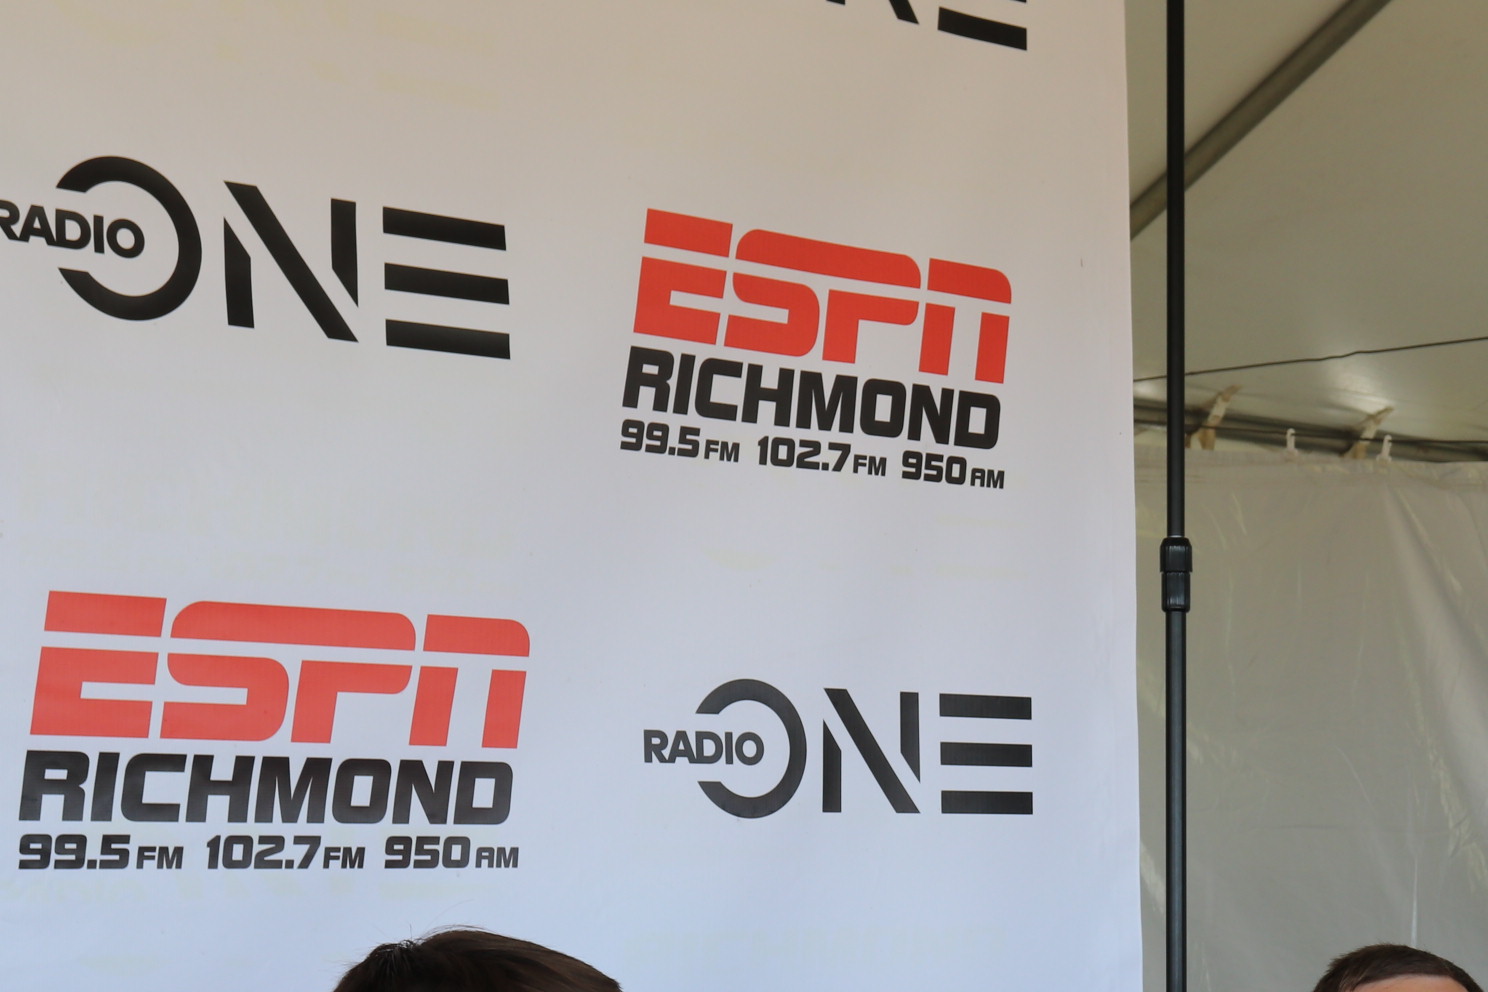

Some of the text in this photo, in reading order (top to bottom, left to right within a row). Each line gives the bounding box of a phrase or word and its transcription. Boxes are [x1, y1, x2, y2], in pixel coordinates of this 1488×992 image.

[55, 155, 511, 360] ONE
[634, 208, 1012, 384] ESPN
[622, 346, 1001, 450] RICHMOND
[29, 591, 531, 749] ESPN
[18, 750, 514, 826] RICHMOND
[643, 729, 765, 766] RADIO
[695, 678, 1034, 819] ONE
